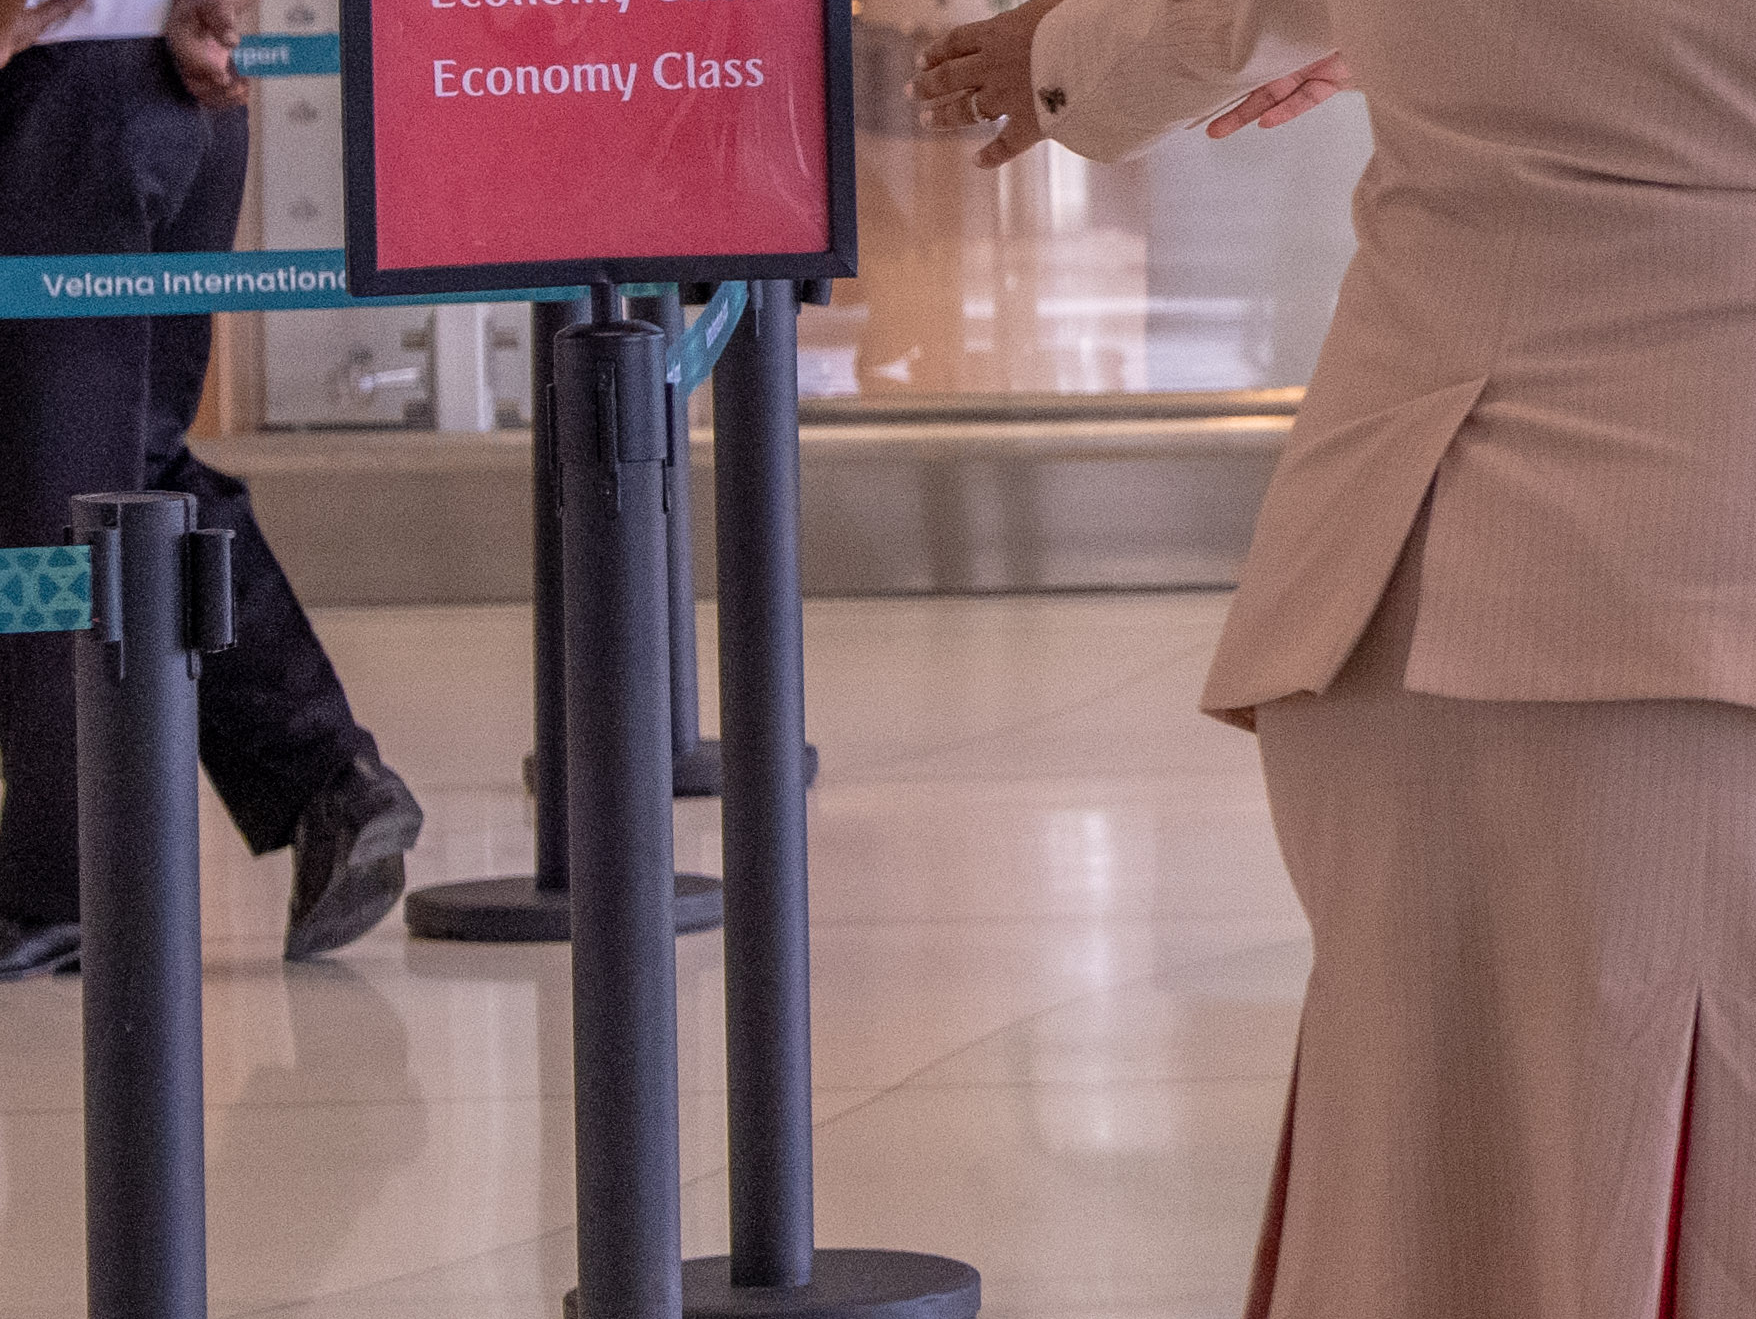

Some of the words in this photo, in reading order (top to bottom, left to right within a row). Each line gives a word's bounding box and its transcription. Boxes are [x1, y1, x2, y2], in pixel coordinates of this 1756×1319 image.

[235, 45, 290, 68] port
[433, 57, 638, 103] Economy
[652, 50, 766, 91] Class
[42, 272, 155, 298] Velana
[163, 265, 346, 295] Internation
